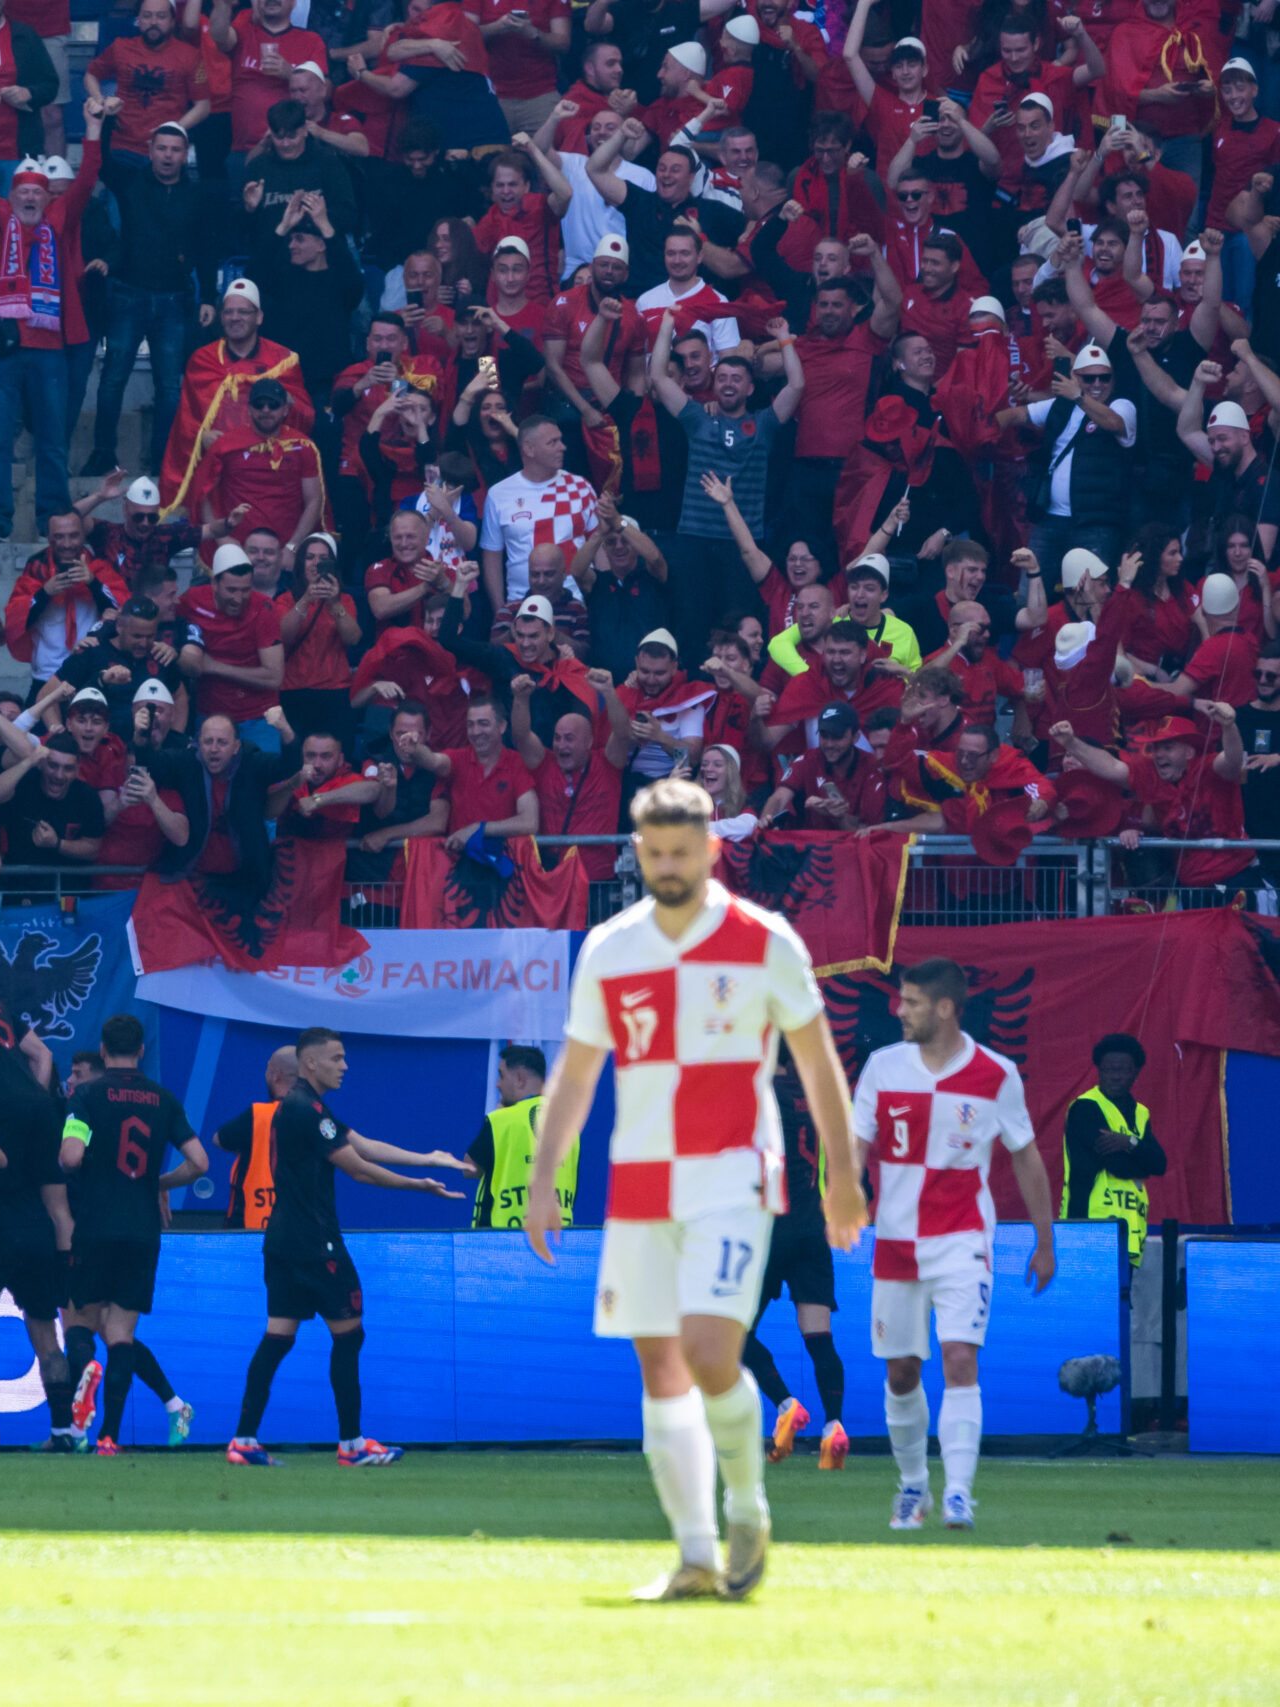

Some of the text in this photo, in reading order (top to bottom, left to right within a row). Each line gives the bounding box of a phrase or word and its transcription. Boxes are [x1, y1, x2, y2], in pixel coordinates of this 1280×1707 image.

[724, 429, 735, 447] 5
[381, 958, 561, 993] FARMACI
[620, 1006, 658, 1060] 17
[117, 1115, 151, 1180] 6
[892, 1119, 909, 1158] 9
[718, 1239, 754, 1283] 17
